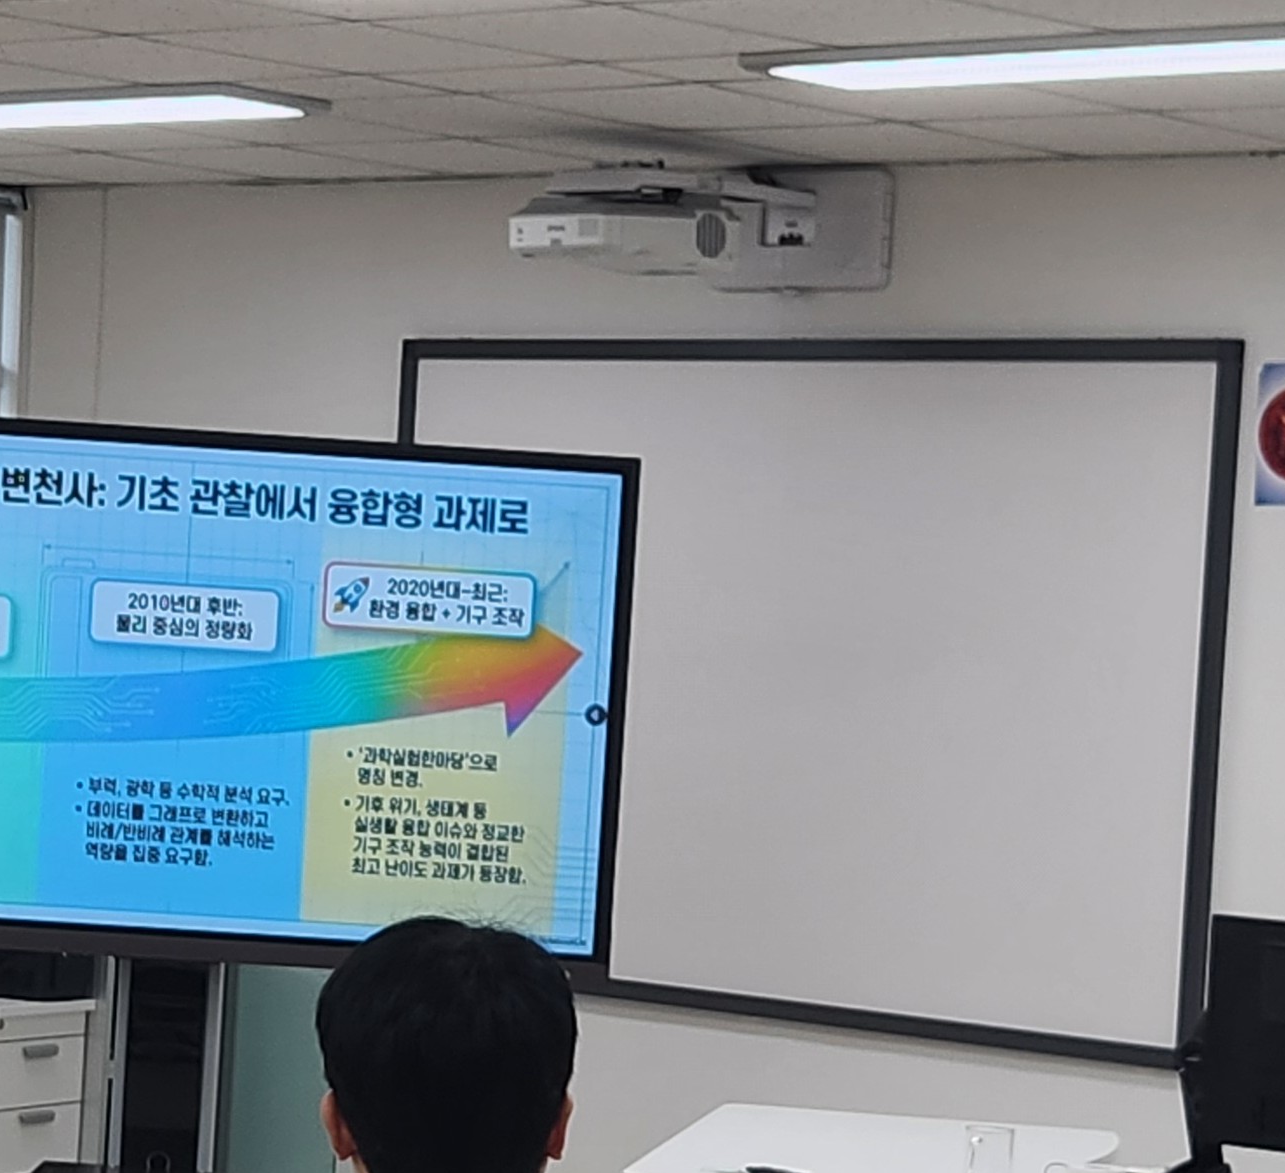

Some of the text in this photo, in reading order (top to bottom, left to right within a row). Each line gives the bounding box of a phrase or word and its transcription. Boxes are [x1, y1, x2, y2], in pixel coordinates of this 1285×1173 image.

[2, 467, 106, 508] 변천사:
[117, 474, 180, 512] 기초
[190, 478, 317, 522] 관찰에서
[328, 488, 422, 527] 융합형
[433, 495, 529, 534] 과제로
[128, 593, 201, 614] 2010년대
[370, 599, 400, 619] 환경
[406, 602, 436, 621] 융합
[457, 605, 487, 624] 기구
[492, 607, 524, 627] 조작
[117, 614, 146, 633] 물리
[153, 616, 199, 636] 중심의
[358, 768, 423, 788] 명칭 변경.
[89, 778, 289, 807] 부력, 광학 등 수학적 분석 요구.
[87, 801, 269, 828] 데이터를 그래프로 변환하고
[356, 795, 486, 820] 기후 위기, 생태계 등
[87, 822, 275, 850] 비례/반비례 관계를 해석하는
[355, 816, 525, 843] 실생활 융합 이슈와 정교한
[86, 842, 212, 867] 역량을 집중 요구함.
[353, 836, 509, 863] 기구 조작 능력이 결합된
[352, 857, 526, 885] 최고 난이도 과제가 등장함.
